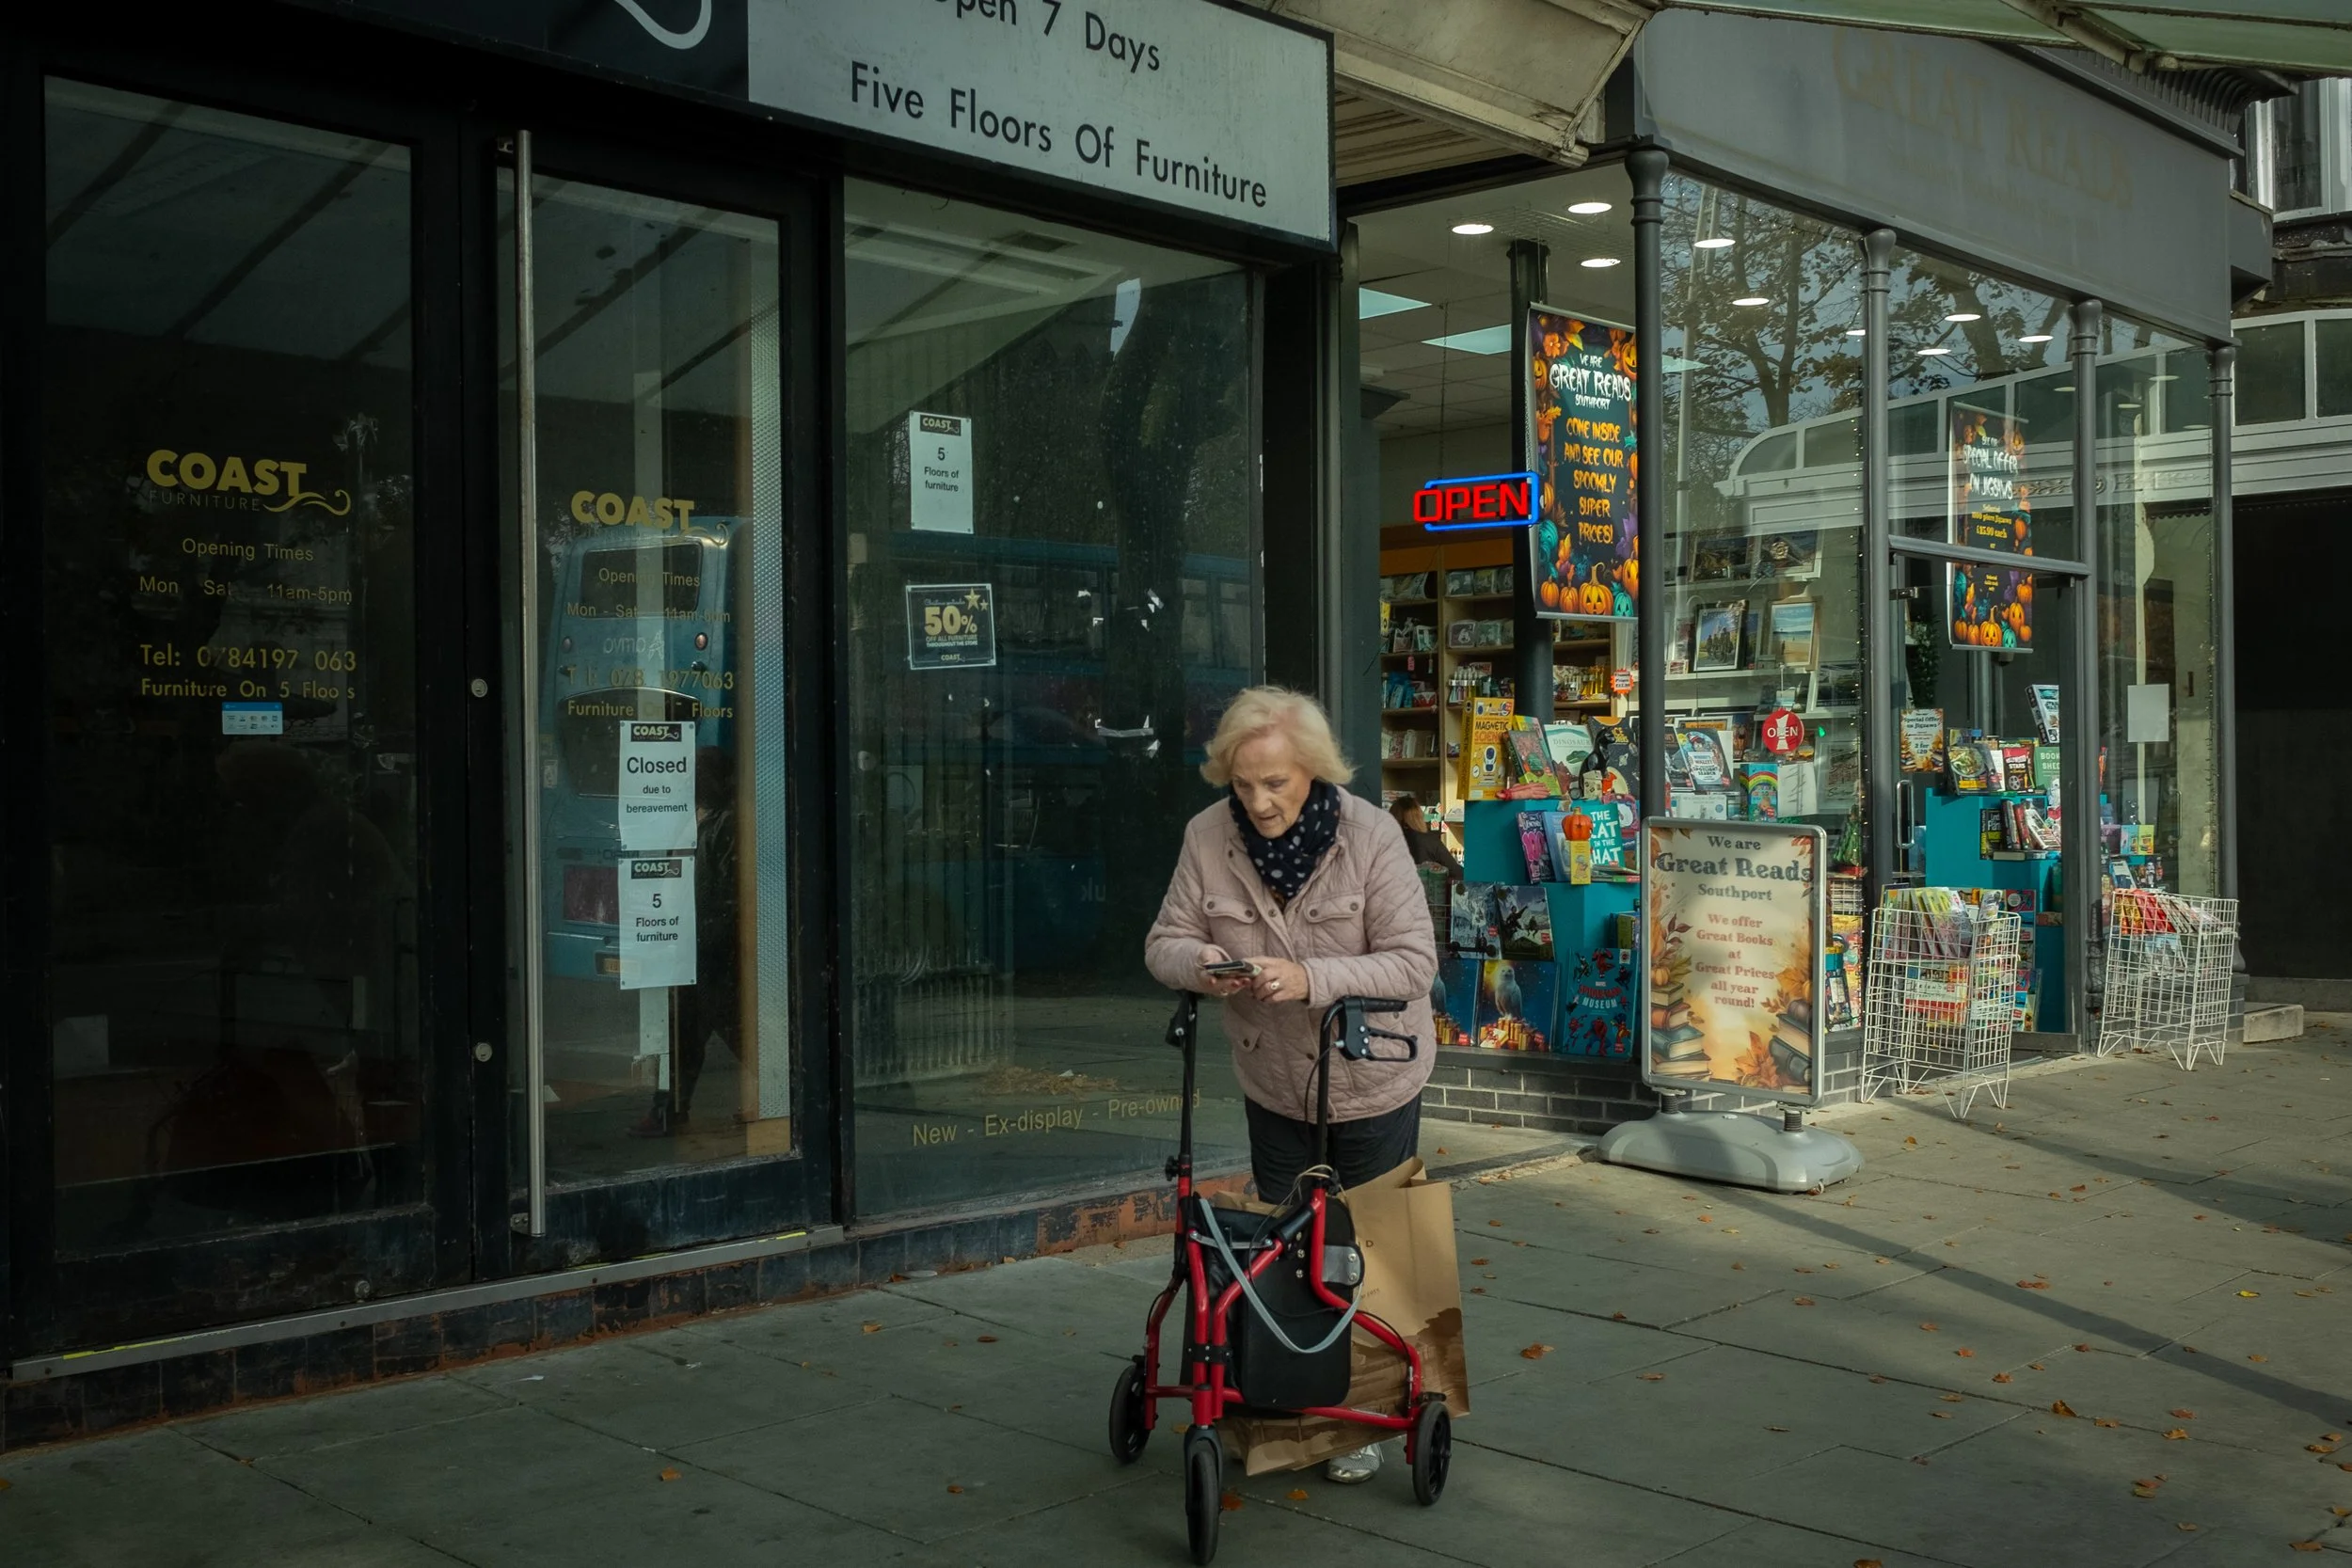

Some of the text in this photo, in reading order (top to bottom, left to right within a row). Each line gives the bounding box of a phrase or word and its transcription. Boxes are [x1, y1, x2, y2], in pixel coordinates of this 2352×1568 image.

[941, 0, 1161, 74] pen 7 Days
[851, 60, 1267, 209] Five Floors Of Furniture
[1590, 355, 1603, 368] ARE
[1549, 363, 1632, 403] GREAT READS
[1575, 393, 1612, 411] SOUTHPORT
[922, 416, 952, 431] COAST
[1565, 417, 1622, 443] COME INSIDE
[937, 447, 946, 462] 5
[1564, 441, 1624, 468] AND SEE OUR
[146, 449, 308, 498] COAST
[923, 466, 960, 480] Floors of
[925, 479, 960, 493] furniture
[149, 489, 261, 513] FURNITURE
[1413, 481, 1529, 523] OPEN
[1579, 496, 1612, 518] SUPER
[571, 490, 695, 531] COAST
[1578, 521, 1613, 545] PRICES!
[183, 537, 314, 562] Opening Times
[661, 571, 701, 588] Times
[140, 575, 180, 594] Mon
[267, 583, 353, 604] 11am-5pm
[567, 601, 597, 617] Mon
[615, 603, 639, 619] Sat
[924, 605, 978, 636] 50%
[140, 642, 182, 668] Tel:
[941, 653, 961, 661] COAST
[566, 666, 597, 687] Tl:
[141, 677, 356, 701] Furniture On 5 Floos
[567, 700, 635, 717] Furniture
[691, 703, 735, 719] Floors
[633, 725, 670, 736] COAST
[1474, 721, 1510, 732] MAGNETIC
[1767, 726, 1799, 738] OEN
[627, 756, 688, 774] Closed
[643, 784, 672, 795] due to
[626, 802, 689, 815] bereavement
[1590, 810, 1612, 821] THE
[1601, 838, 1616, 847] THE
[1708, 834, 1761, 851] We are
[1591, 847, 1622, 865] HAT
[633, 862, 670, 874] COAST
[1656, 851, 1815, 884] Great Reads
[651, 894, 662, 909] 5
[1697, 883, 1772, 902] Southport
[635, 915, 680, 927] Floors of
[1707, 913, 1763, 929] We offer
[636, 930, 679, 943] furniture
[1696, 929, 1773, 947] Great Books
[1727, 949, 1741, 960] at
[1695, 961, 1775, 981] Great Prices
[1710, 980, 1759, 997] all year
[1581, 996, 1618, 1009] MUSEUM
[1714, 994, 1755, 1009] round!
[913, 1121, 958, 1148] New
[985, 1106, 1084, 1137] Ex-display
[1108, 1088, 1201, 1120] Pre-ownd
